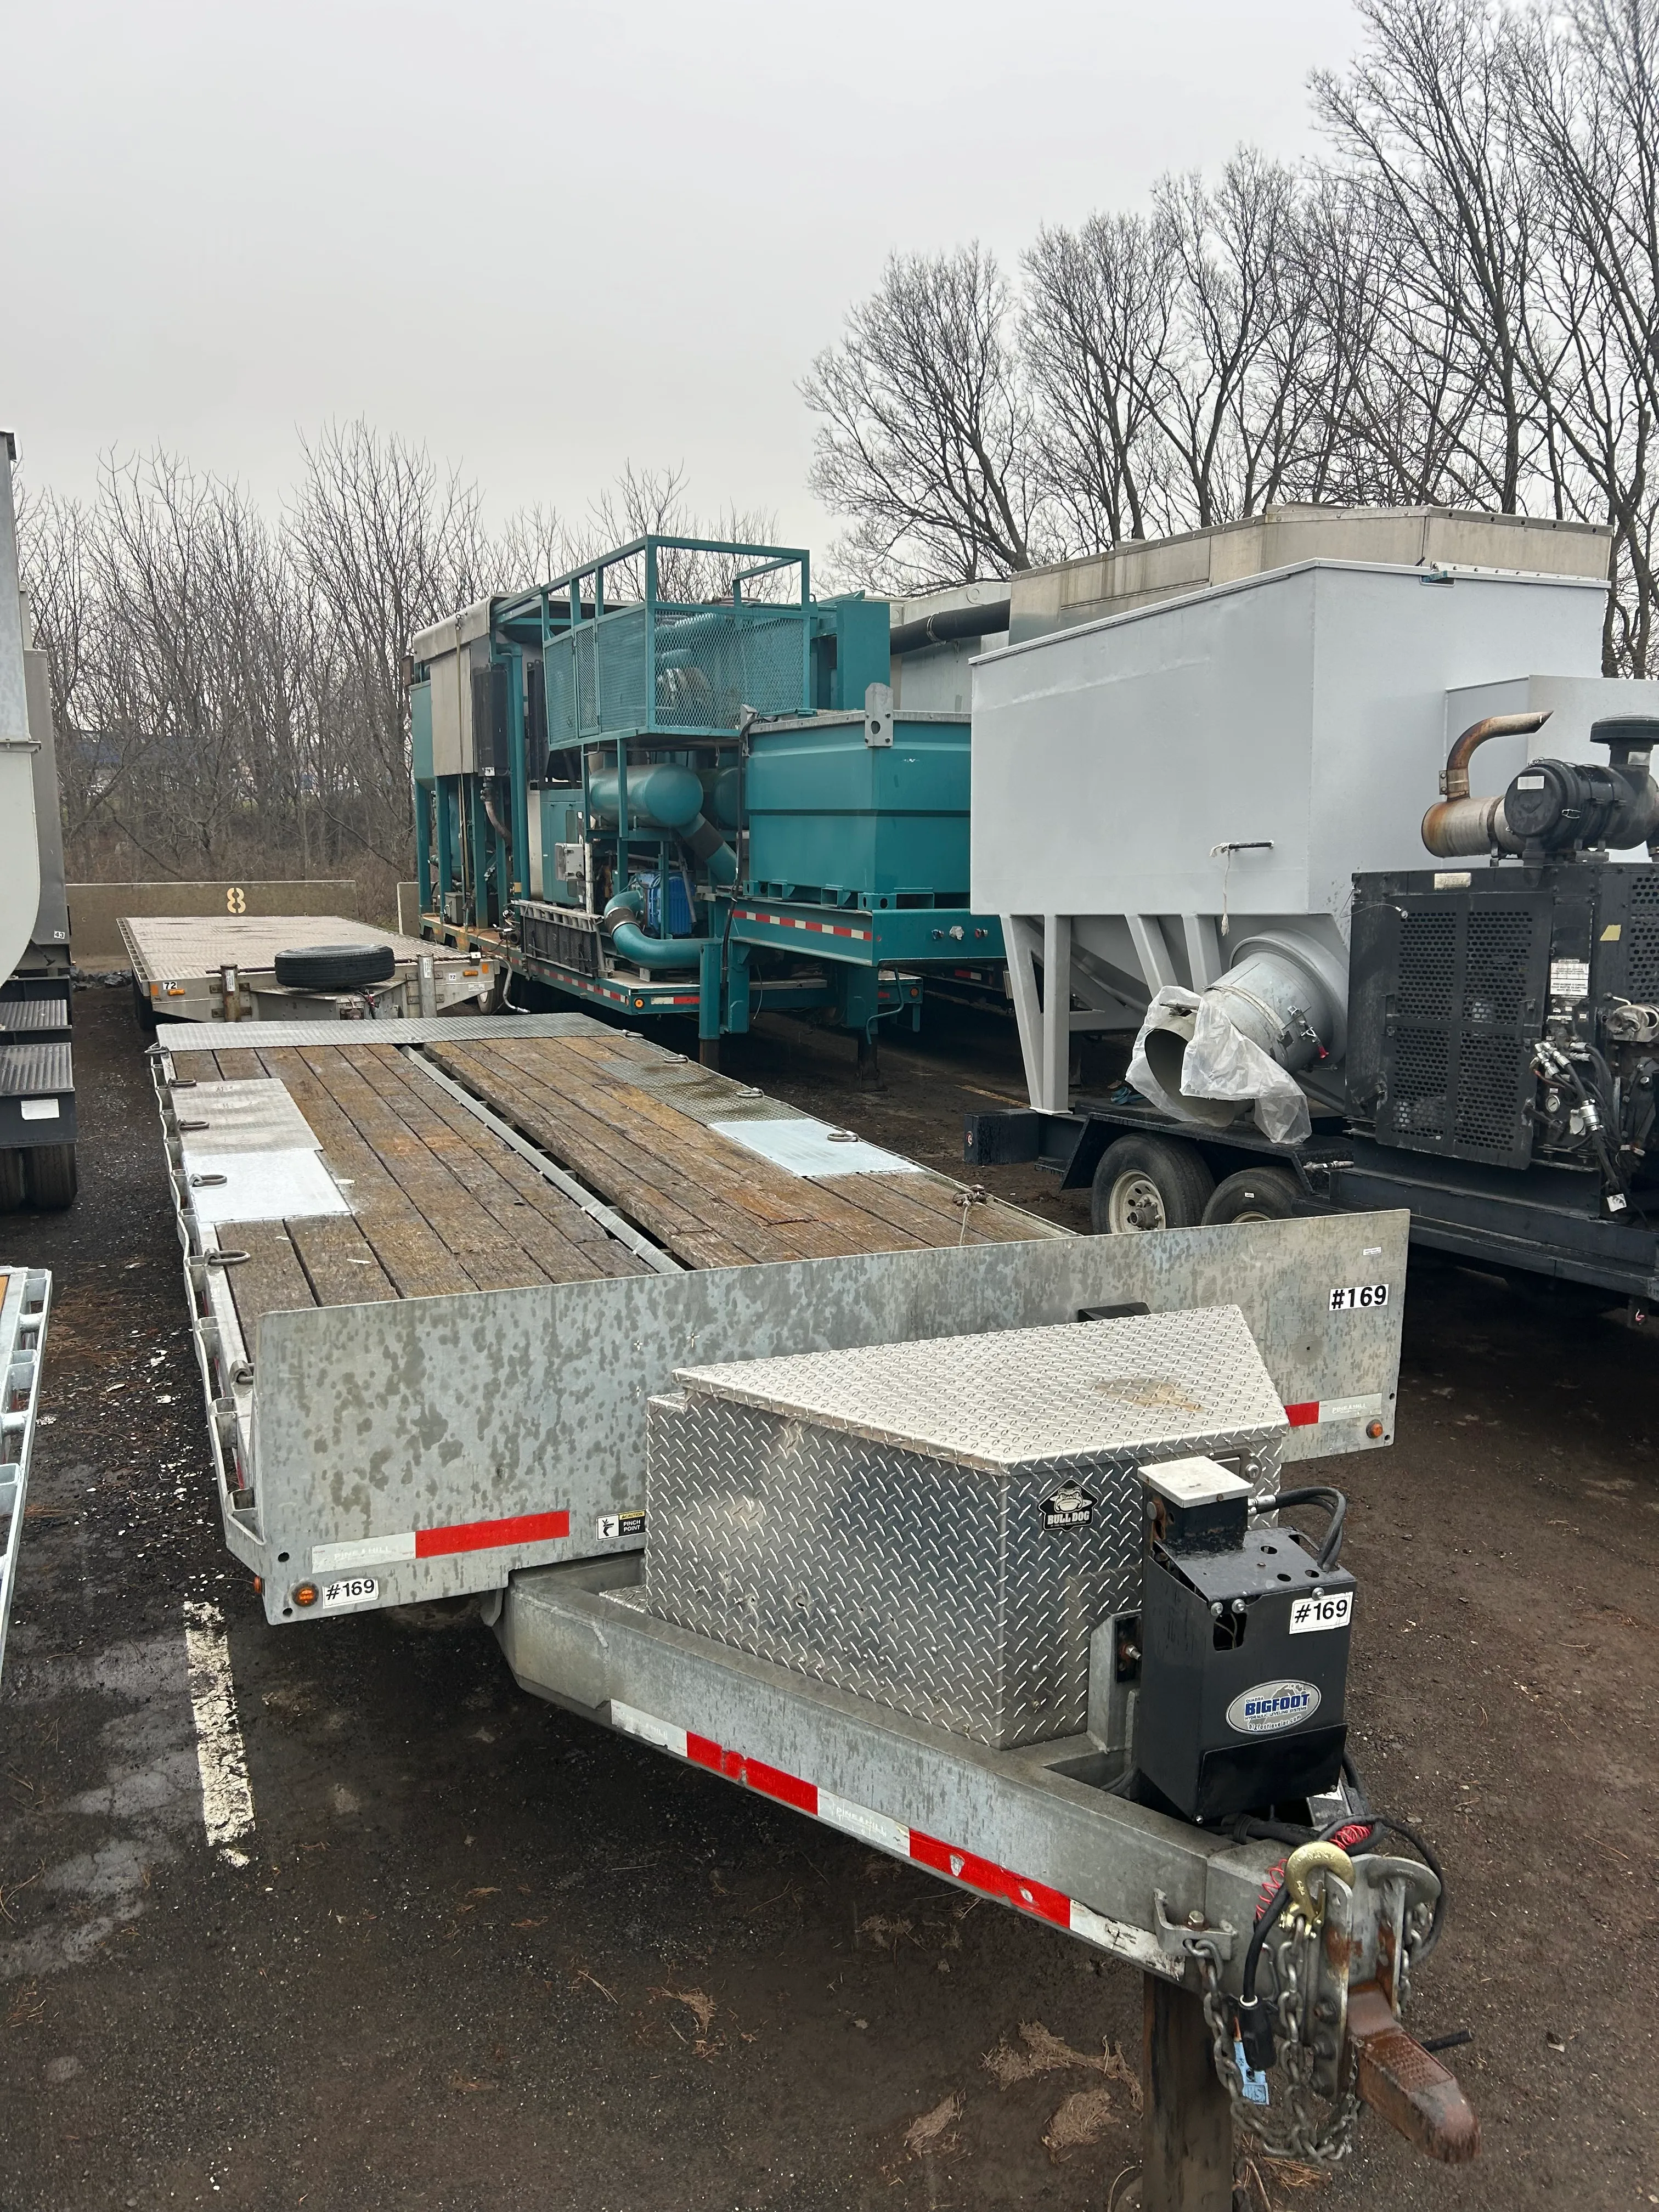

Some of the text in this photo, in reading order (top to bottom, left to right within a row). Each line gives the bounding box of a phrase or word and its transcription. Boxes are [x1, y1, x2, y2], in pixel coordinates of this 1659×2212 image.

[227, 887, 246, 913] 8
[164, 981, 177, 990] 72
[1331, 1285, 1386, 1310] #169
[1047, 1513, 1071, 1525] BULL
[1071, 1510, 1090, 1522] DOG
[368, 1545, 391, 1555] HILL
[326, 1579, 375, 1601] #169
[1295, 1599, 1348, 1624] #169
[1245, 1693, 1310, 1716] BIGFOOT
